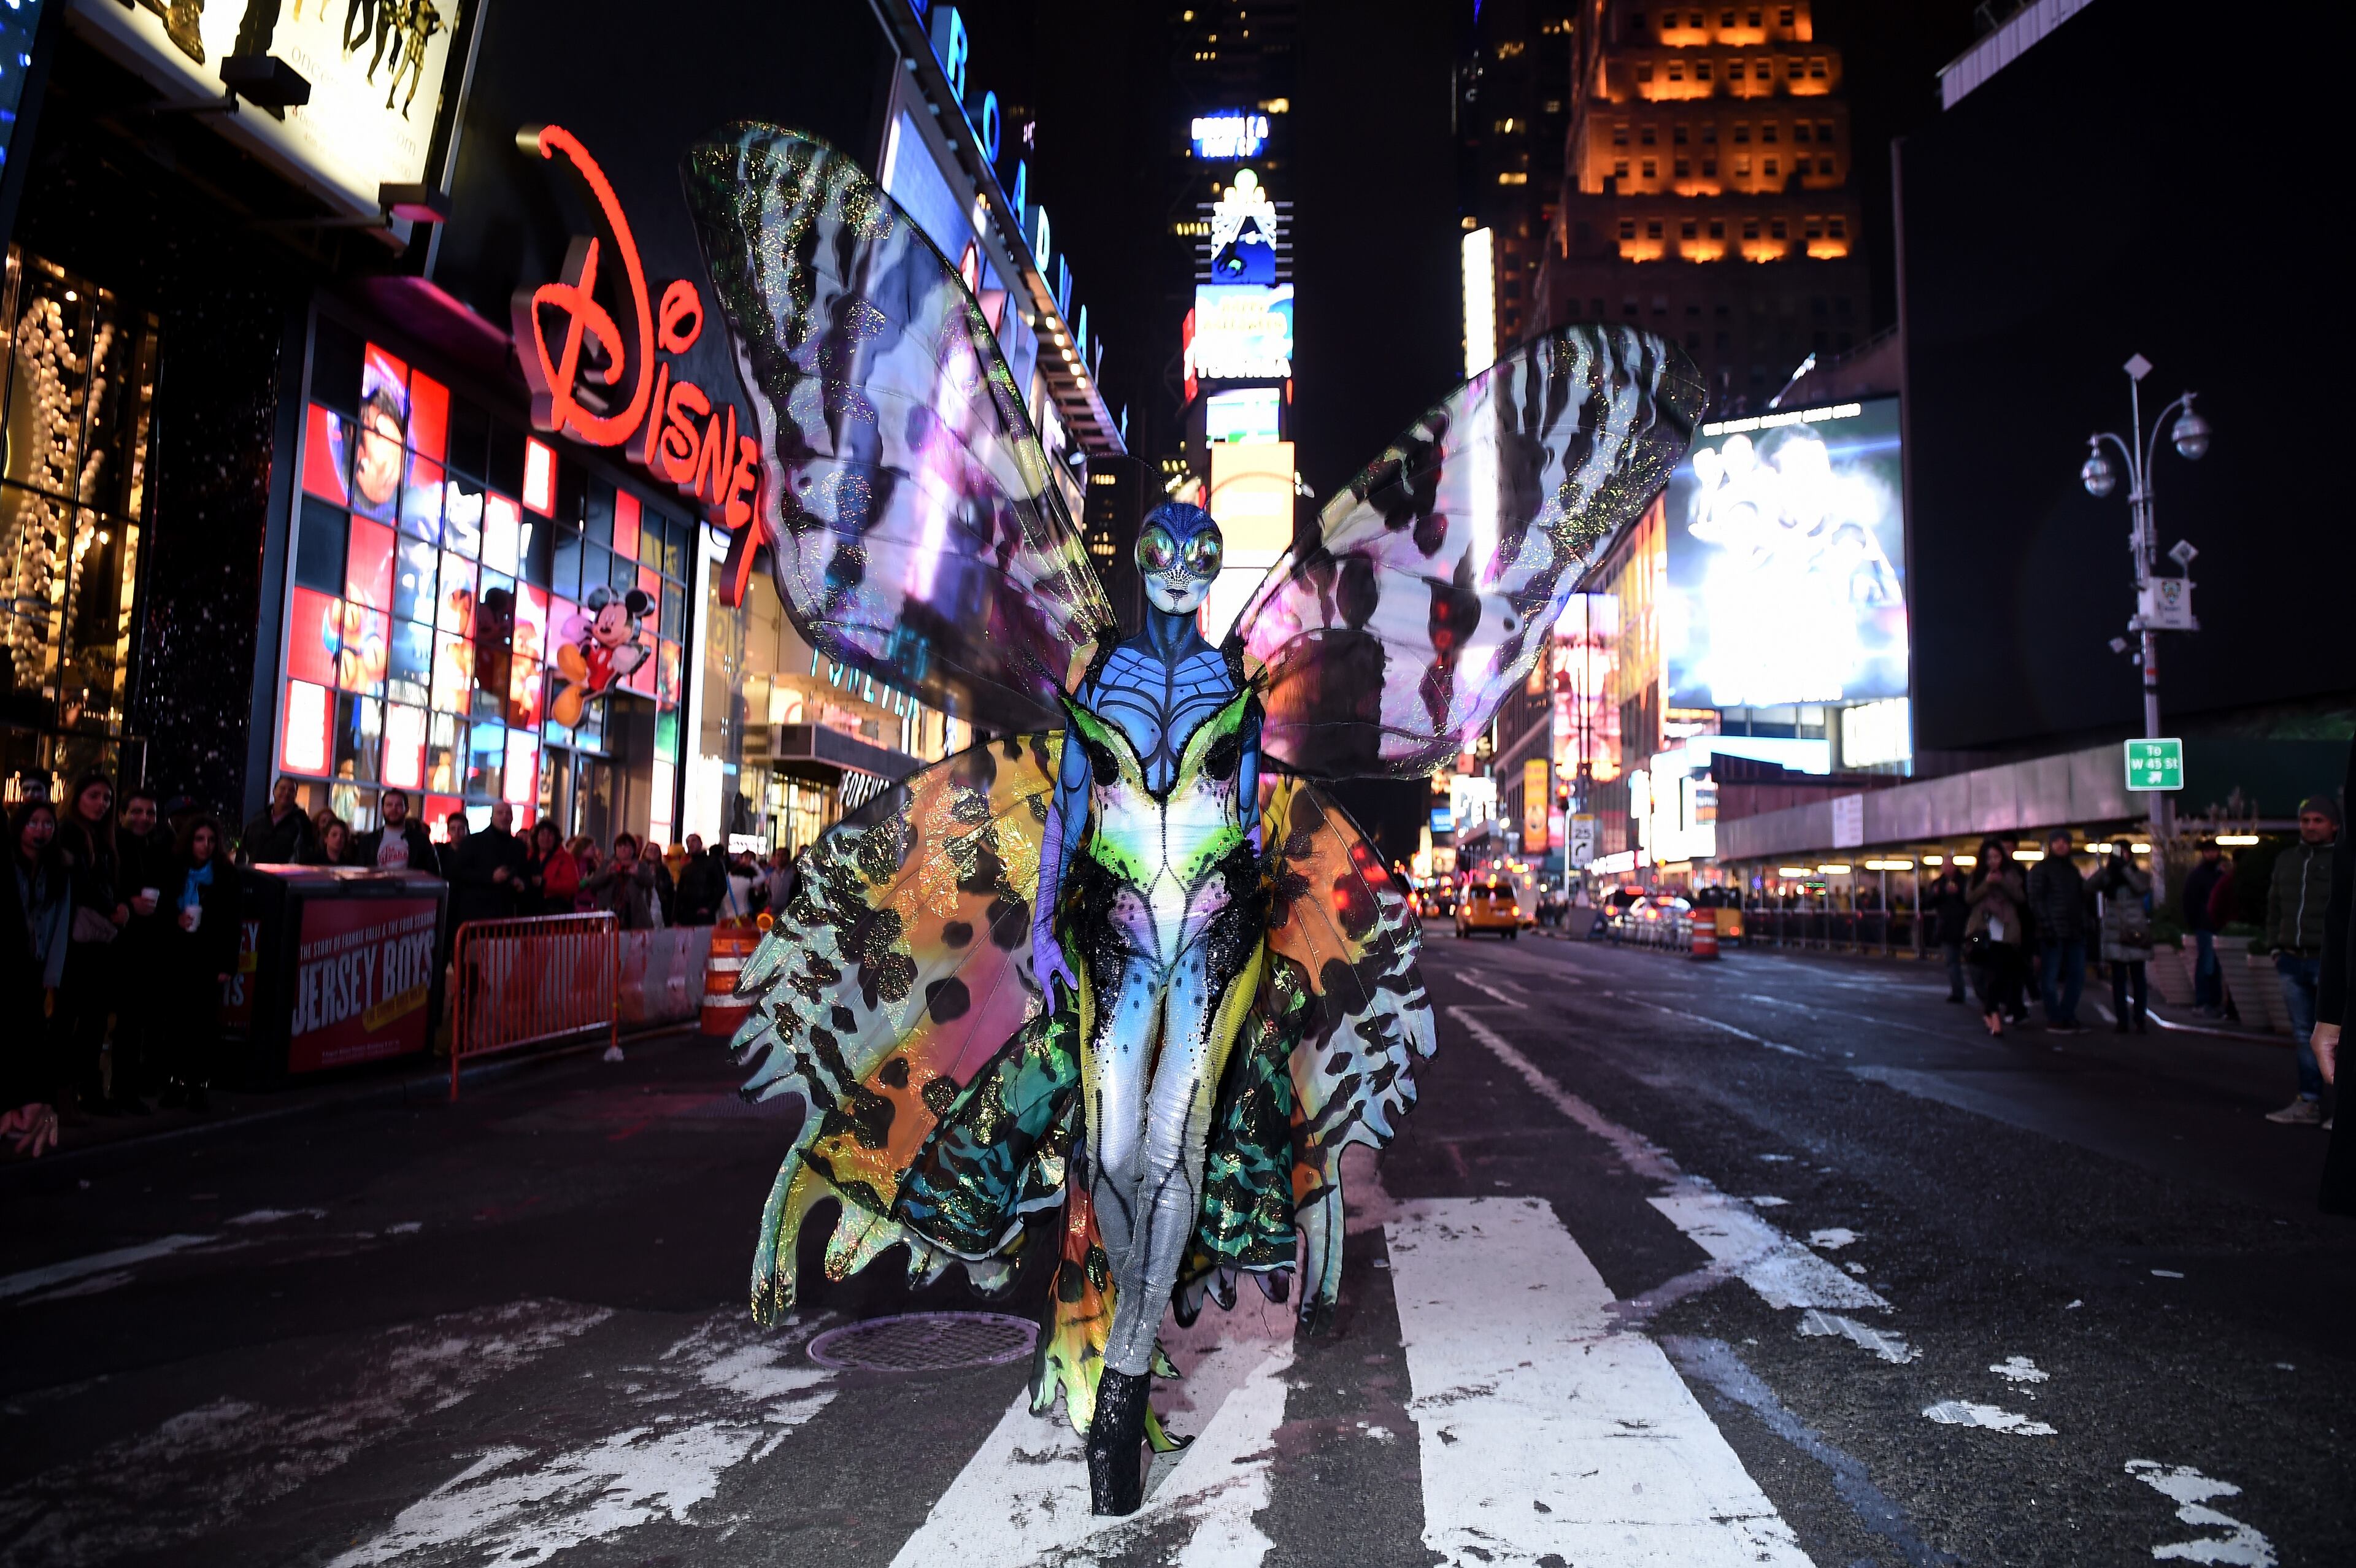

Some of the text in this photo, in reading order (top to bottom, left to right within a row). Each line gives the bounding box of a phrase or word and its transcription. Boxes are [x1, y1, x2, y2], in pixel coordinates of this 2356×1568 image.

[913, 0, 1103, 388] ROADWAY
[2146, 745, 2162, 756] To
[2130, 757, 2178, 770] W 45 St
[314, 937, 332, 957] STORY
[334, 936, 340, 951] OF
[291, 944, 378, 1038] JERSEY
[382, 928, 436, 1002] BOYS
